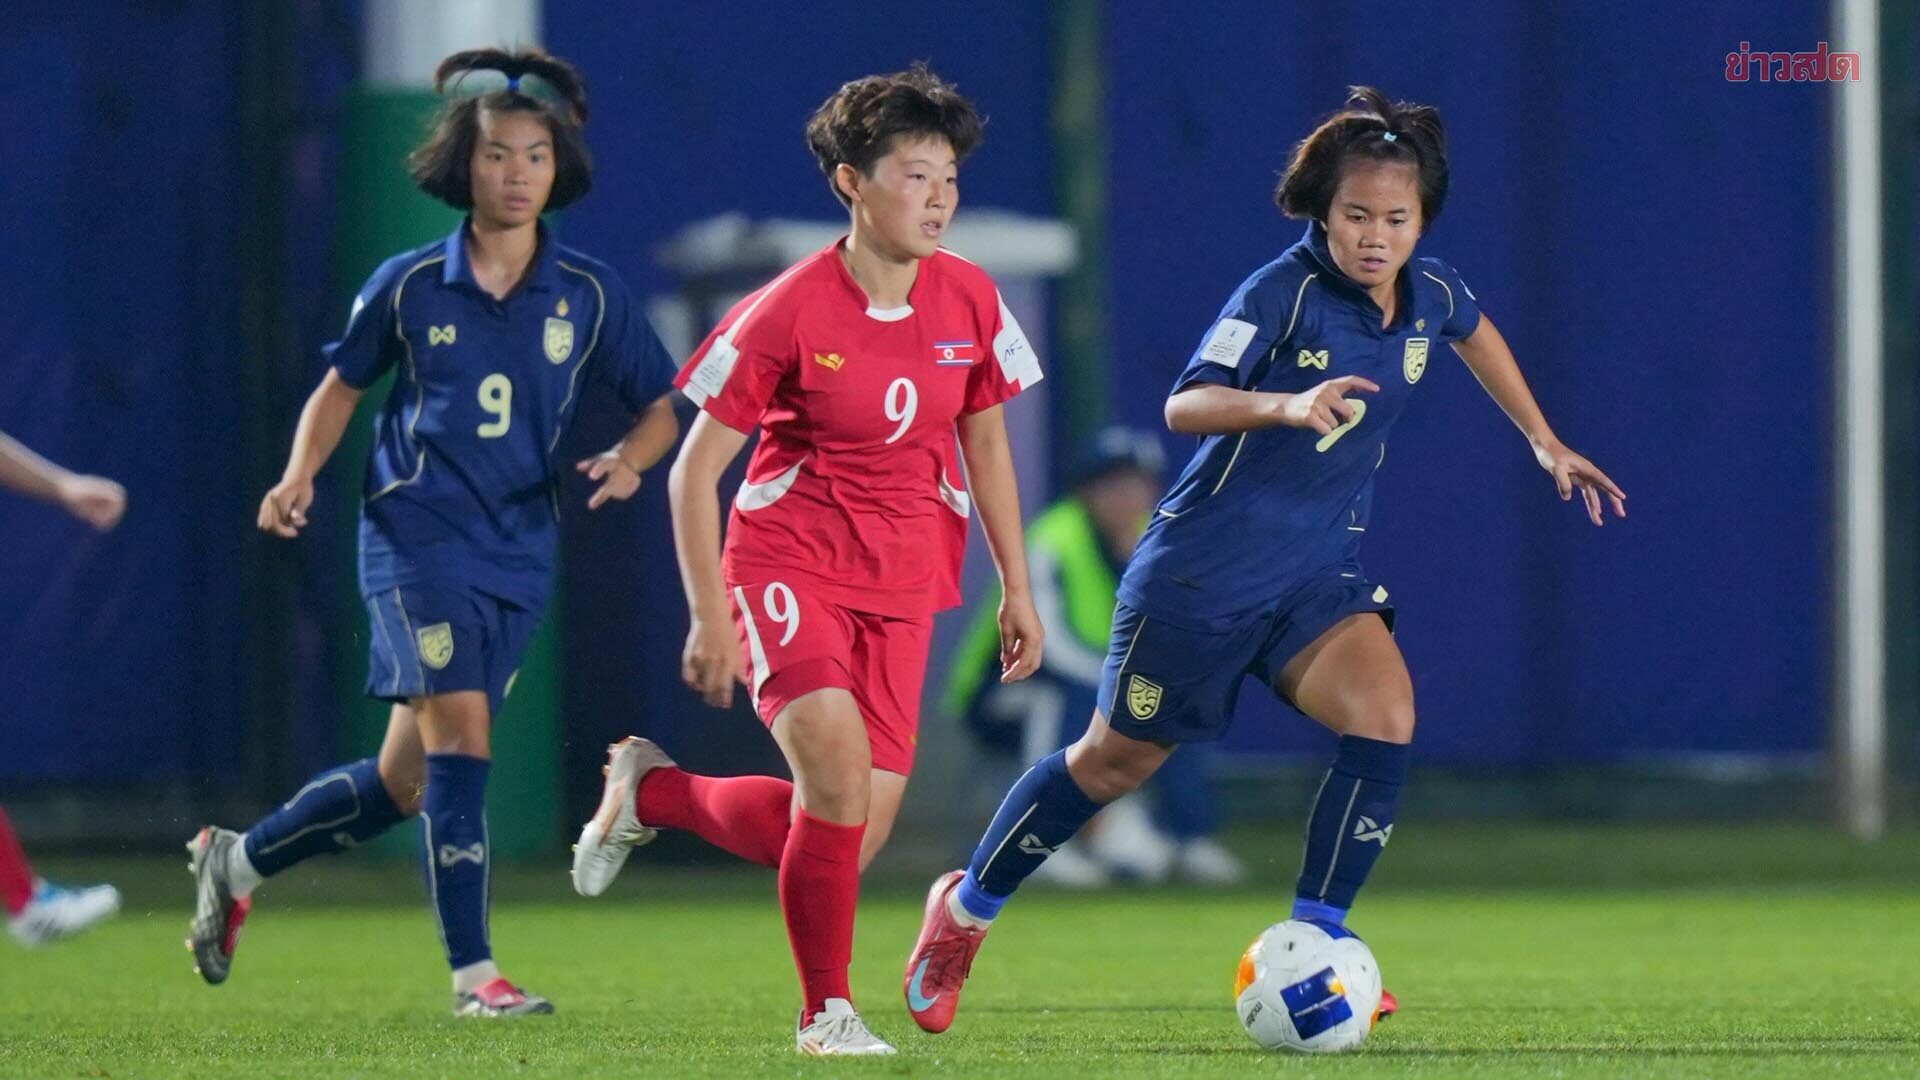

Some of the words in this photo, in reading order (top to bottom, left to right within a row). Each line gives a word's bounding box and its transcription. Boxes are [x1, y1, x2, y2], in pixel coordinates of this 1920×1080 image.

[477, 373, 512, 438] 9
[884, 377, 918, 445] 9
[763, 581, 800, 646] 9
